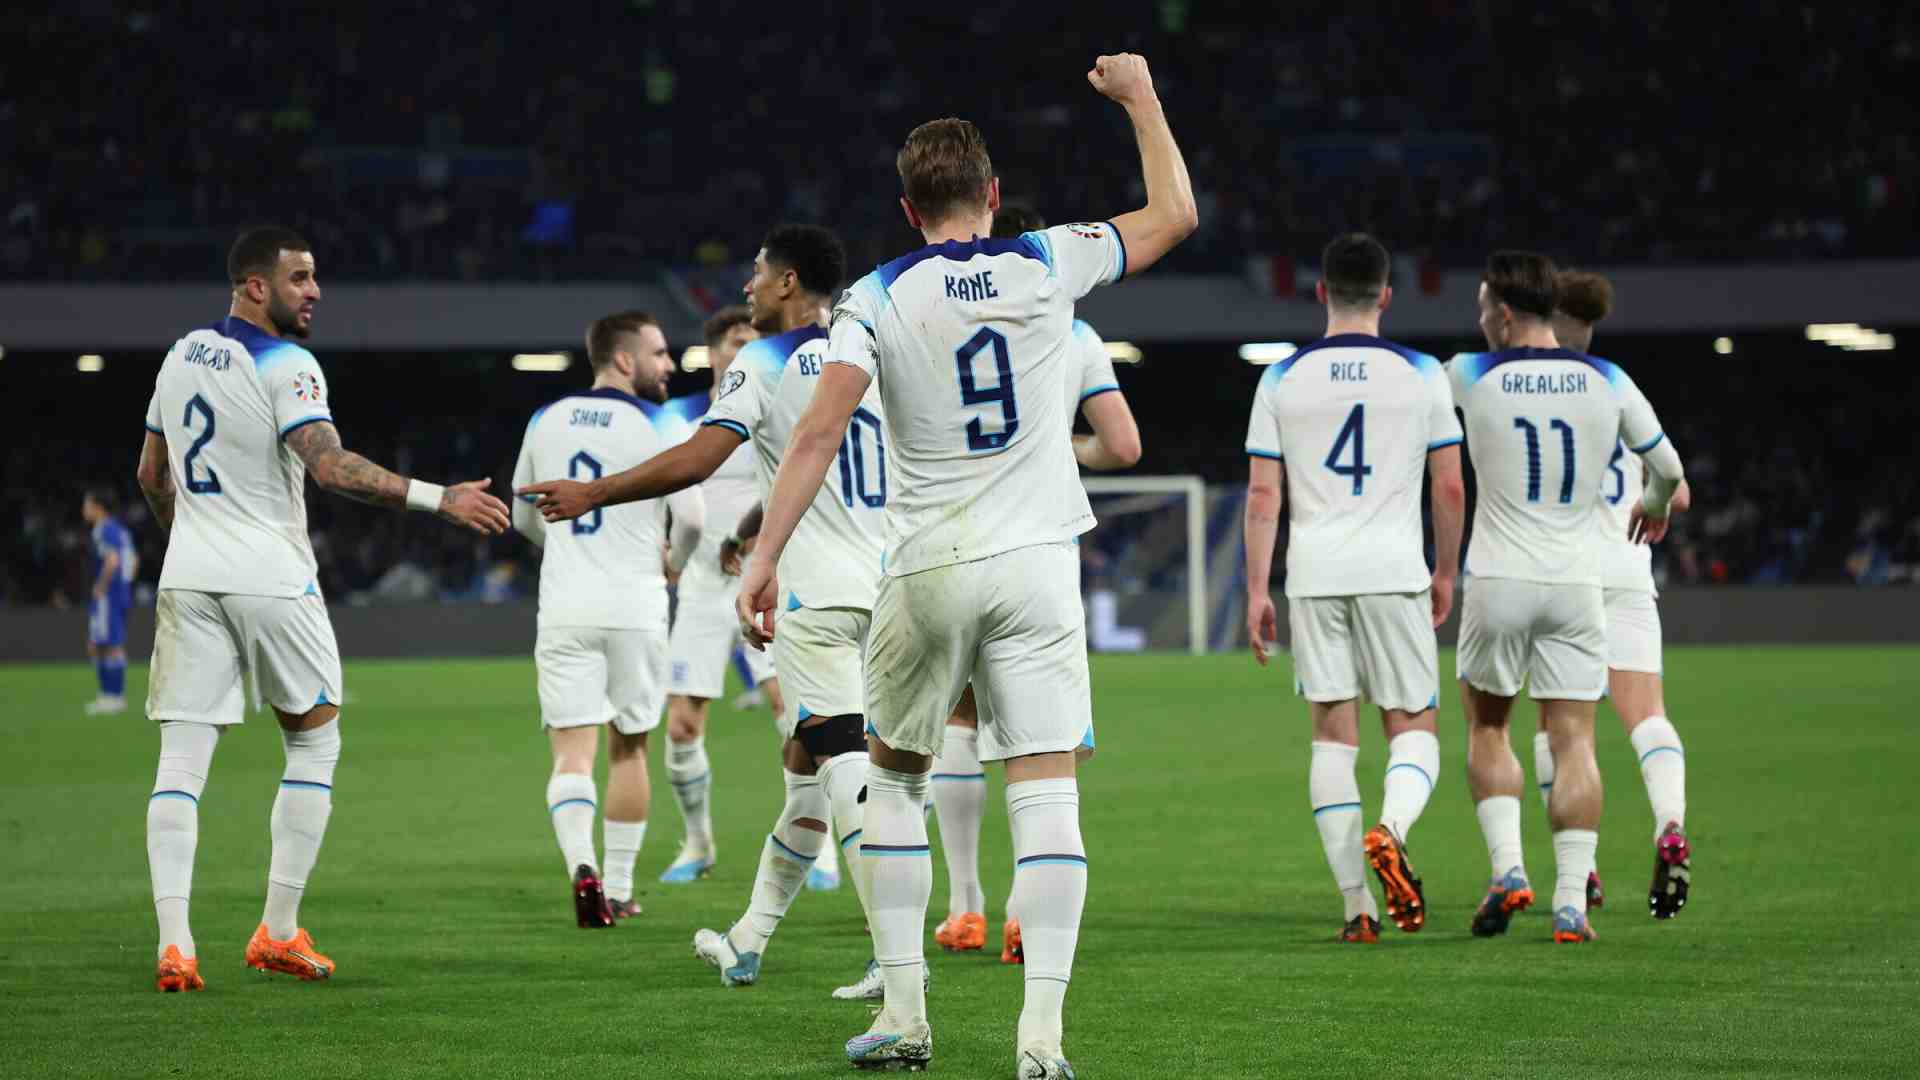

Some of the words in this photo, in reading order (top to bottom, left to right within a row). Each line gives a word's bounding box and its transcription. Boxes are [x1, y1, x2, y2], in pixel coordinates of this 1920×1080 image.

[945, 271, 998, 301] KANE
[956, 326, 1019, 451] 9
[1329, 361, 1368, 382] RICE
[1502, 373, 1587, 394] GREALISH
[184, 393, 222, 494] 2
[569, 408, 612, 428] SHAW
[838, 405, 887, 508] 10
[1324, 403, 1372, 497] 4
[1513, 417, 1576, 504] 11
